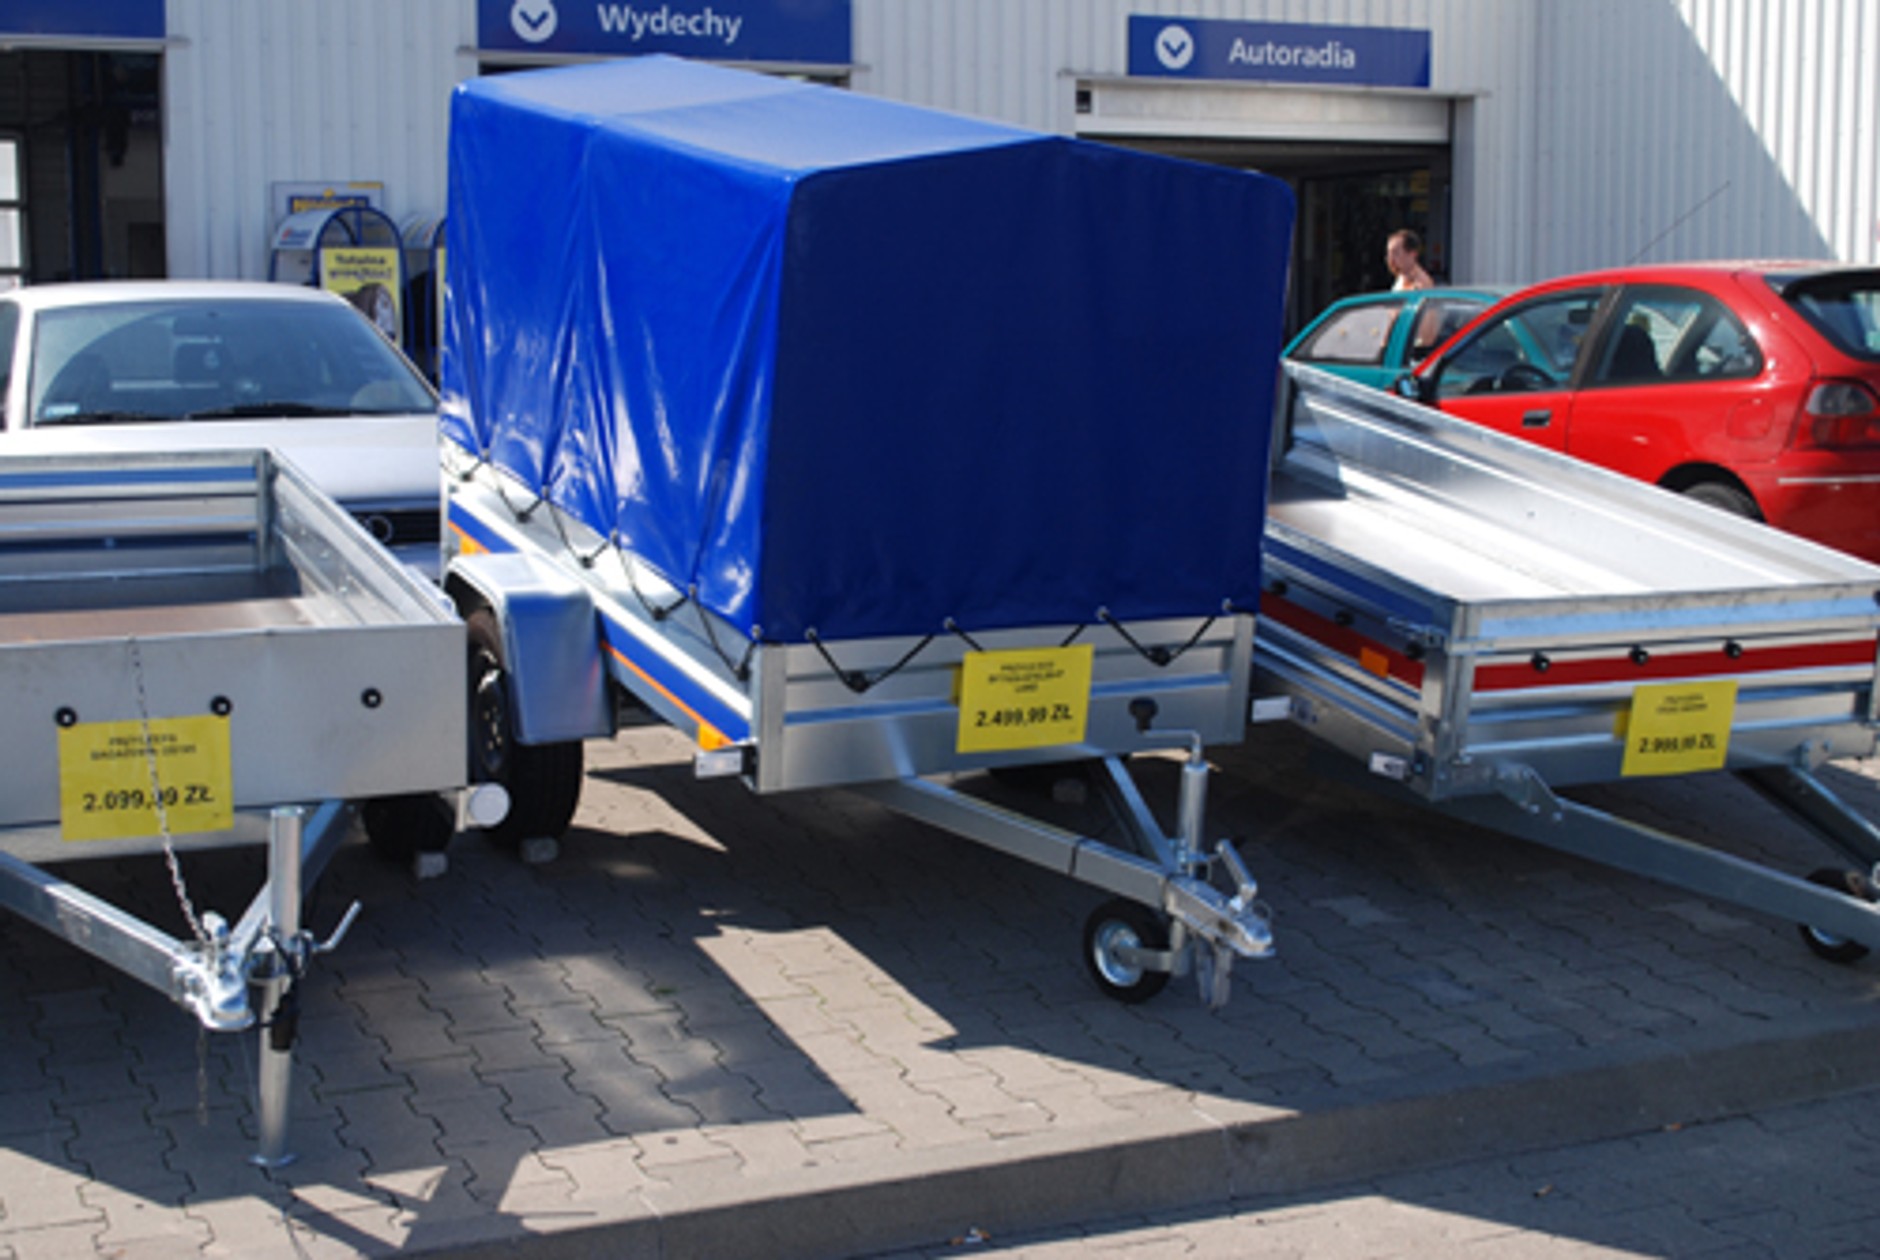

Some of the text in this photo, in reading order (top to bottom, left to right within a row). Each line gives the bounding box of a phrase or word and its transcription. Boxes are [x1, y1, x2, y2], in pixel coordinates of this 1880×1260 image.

[597, 4, 742, 44] Wydechy
[1229, 38, 1356, 69] Autoradia
[184, 784, 215, 805] ZŁ
